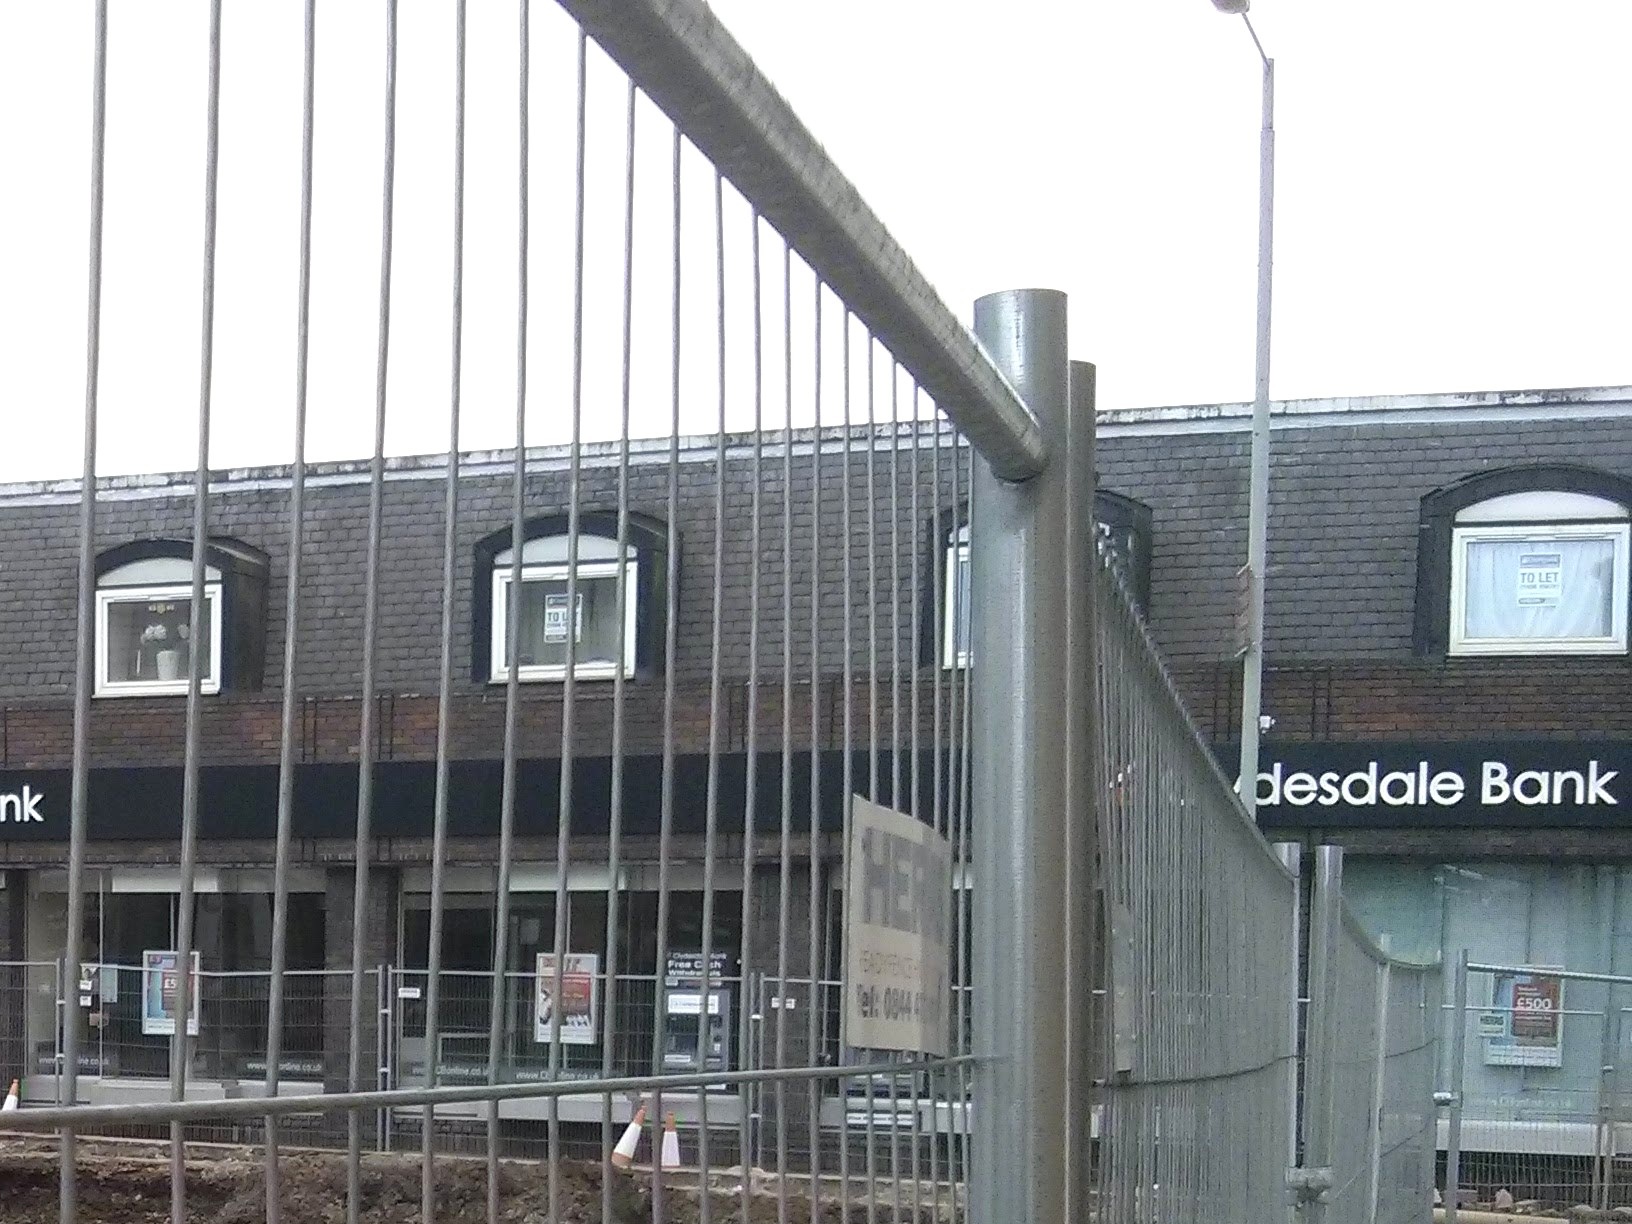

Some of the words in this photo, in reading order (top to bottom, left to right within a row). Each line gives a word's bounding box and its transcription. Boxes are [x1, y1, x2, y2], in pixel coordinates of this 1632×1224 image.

[1520, 572, 1535, 583] TO
[1538, 572, 1559, 583] LET
[548, 612, 559, 622] TO
[1234, 761, 1465, 805] desdale
[1481, 760, 1619, 805] Bank
[668, 960, 691, 968] Free
[694, 960, 722, 969] Csh
[1517, 997, 1552, 1010] £500
